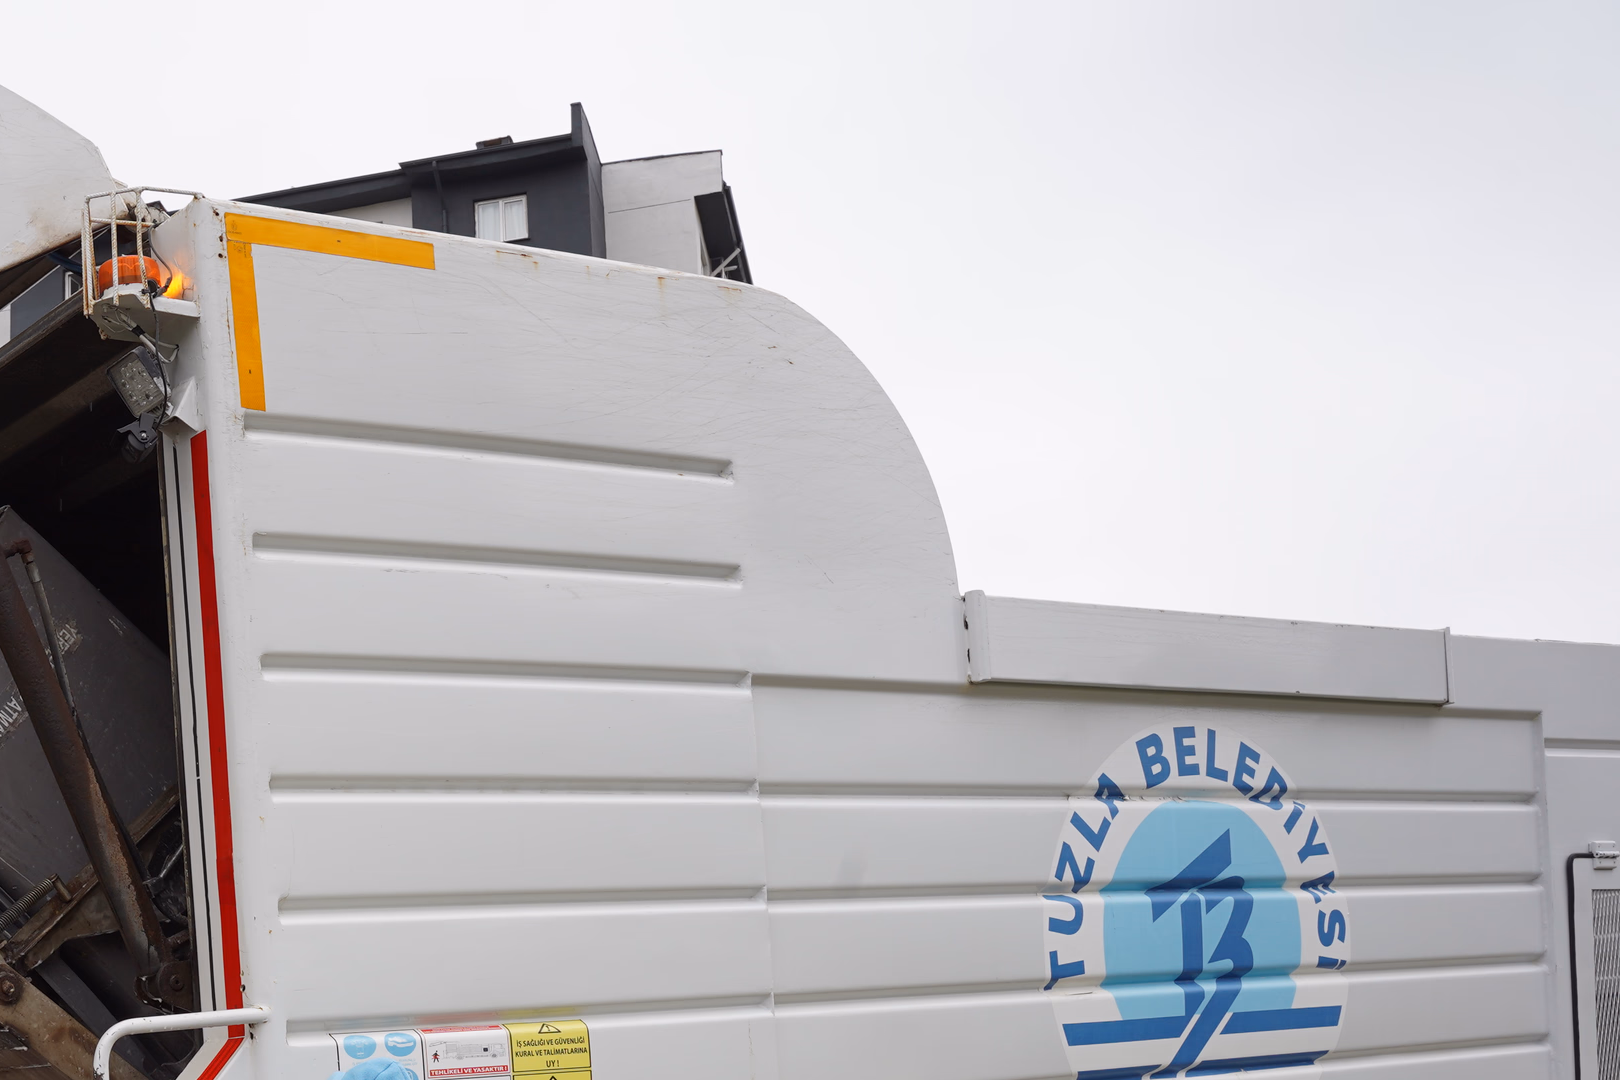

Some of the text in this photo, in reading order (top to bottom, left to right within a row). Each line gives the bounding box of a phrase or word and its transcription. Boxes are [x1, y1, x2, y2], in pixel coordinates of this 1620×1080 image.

[1042, 725, 1348, 992] TUZLA BELEDİYESİ
[517, 1040, 522, 1048] İŞ
[523, 1039, 545, 1047] SAĞLIĞI
[555, 1036, 585, 1044] GÜVENLİĞİ
[544, 1047, 587, 1056] TALİMATLARINA
